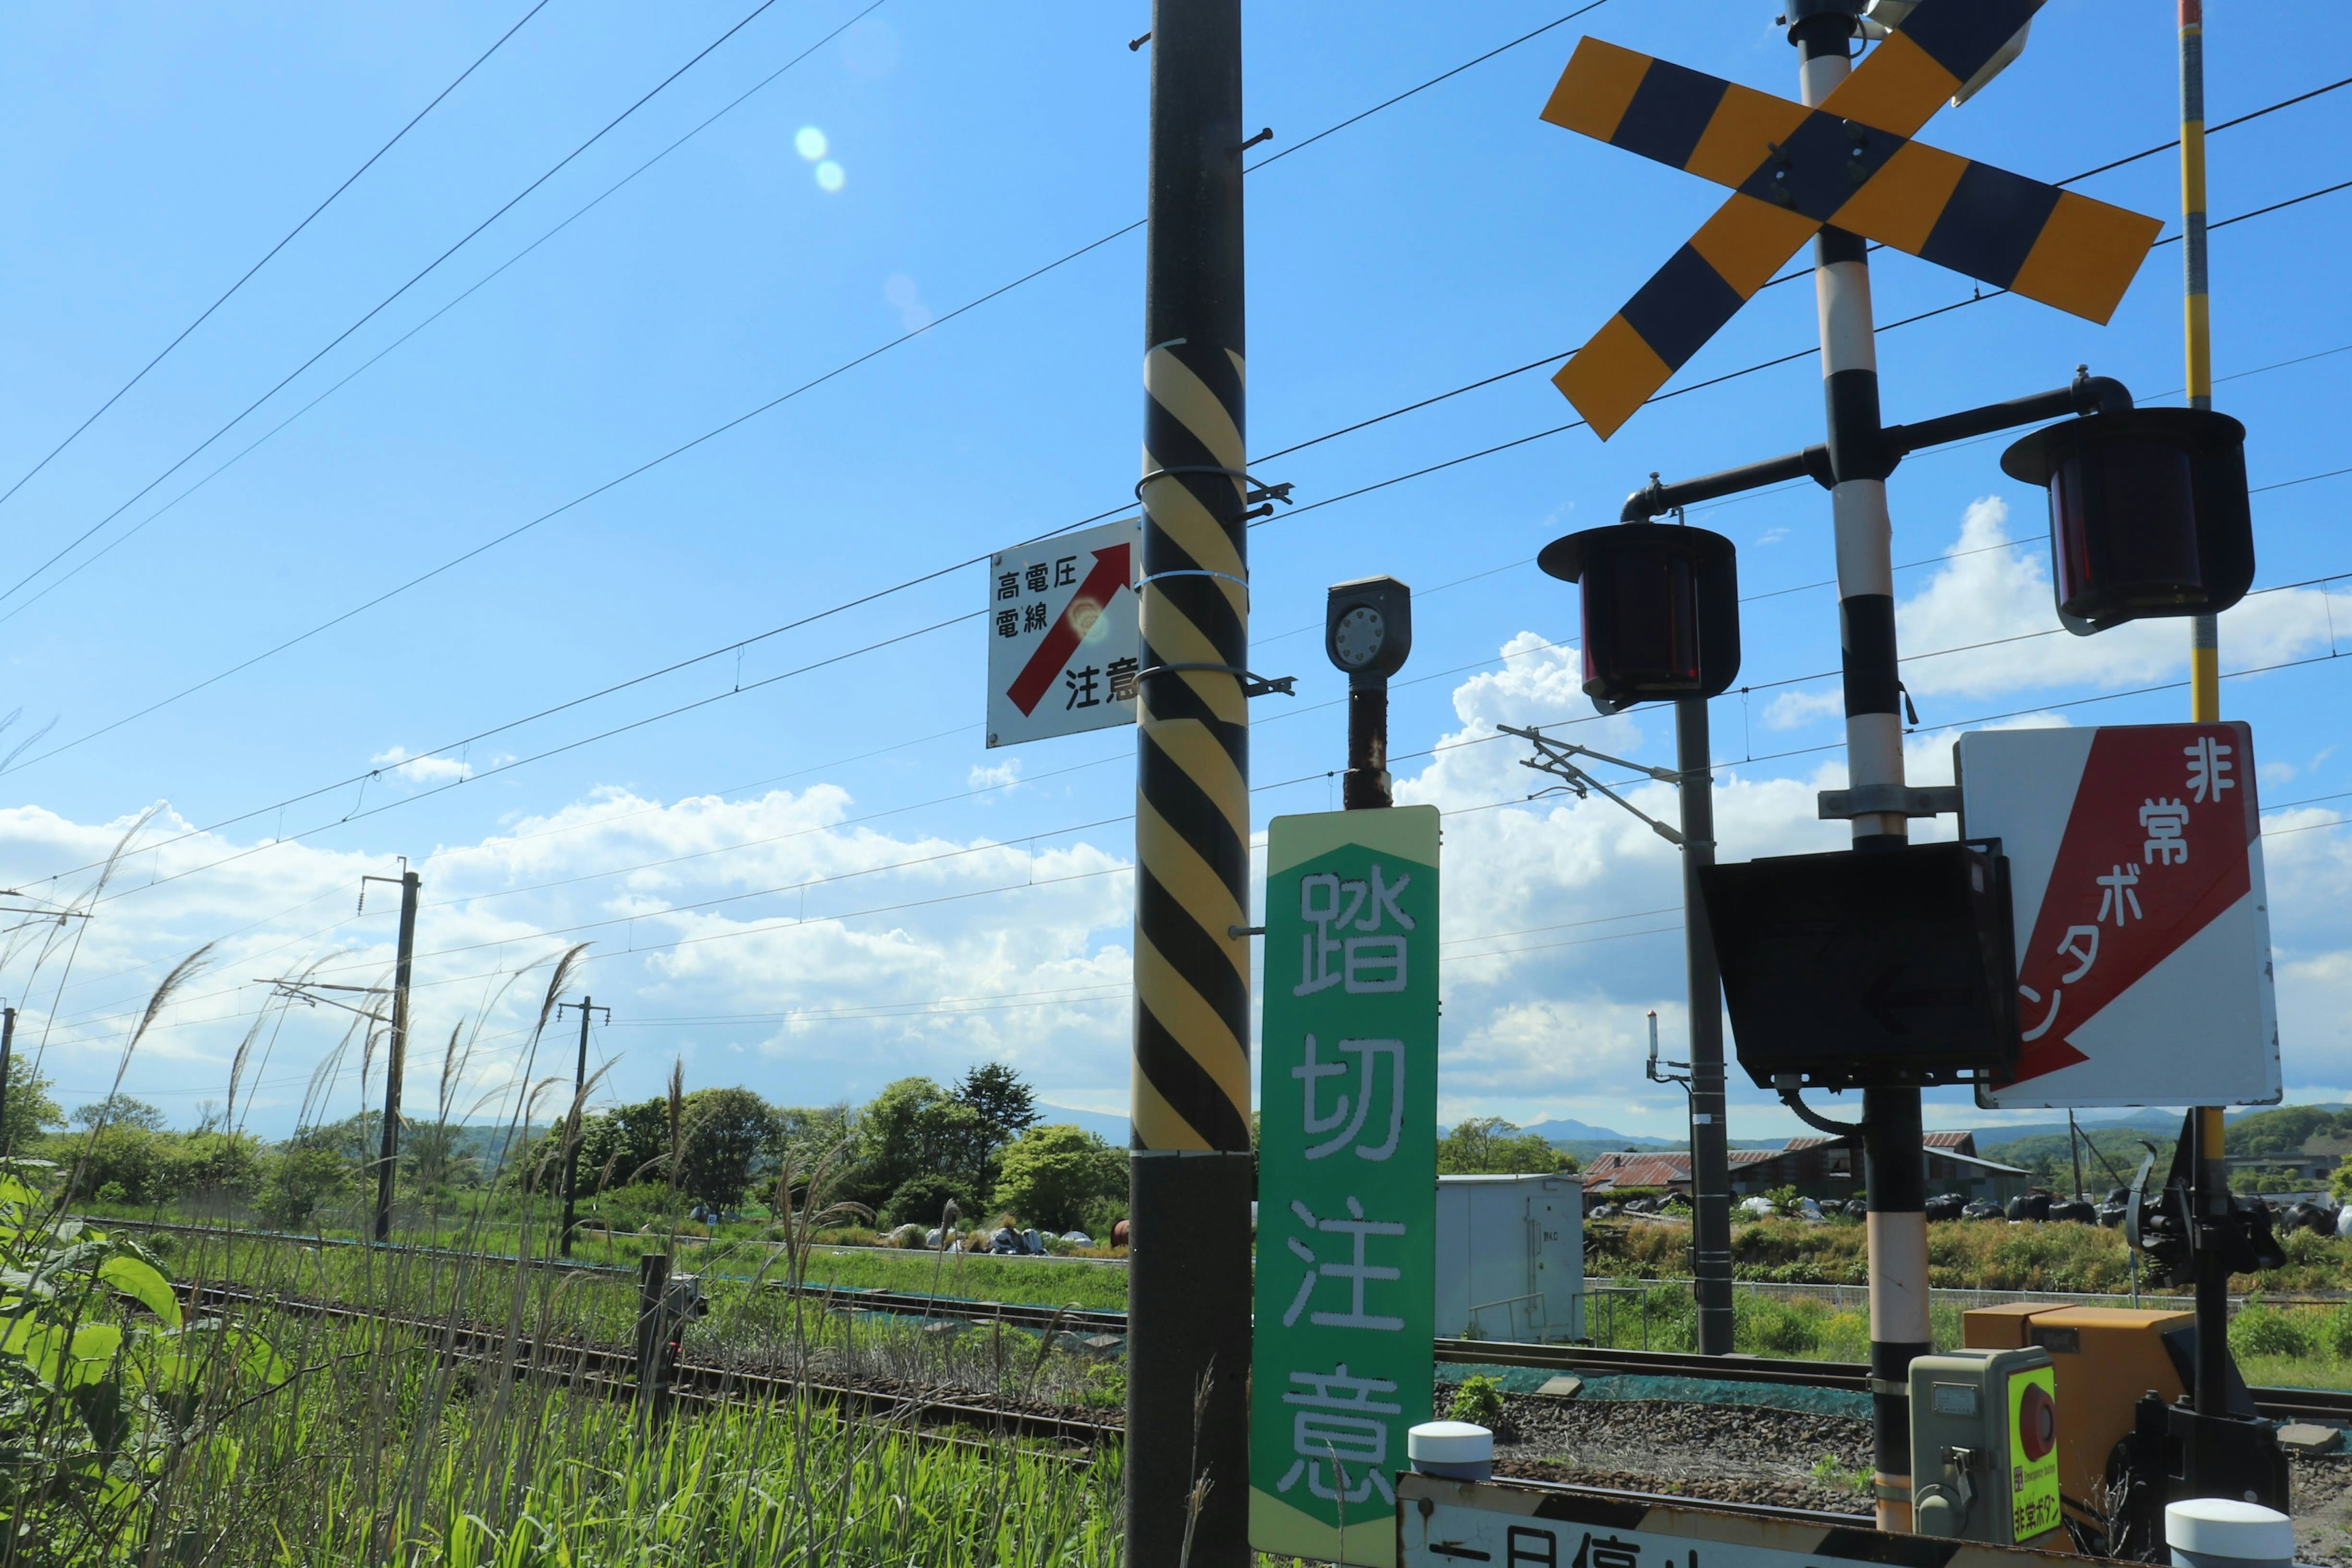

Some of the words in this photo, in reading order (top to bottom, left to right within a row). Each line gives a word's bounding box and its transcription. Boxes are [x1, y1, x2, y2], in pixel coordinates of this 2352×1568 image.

[997, 555, 1077, 601] 高電圧
[996, 601, 1047, 638] 電線
[1066, 657, 1138, 711] 注意
[2018, 736, 2235, 1042] 非常ボタン
[1276, 862, 1417, 1507] 踏切注意
[2014, 1494, 2059, 1535] 非常ボタン
